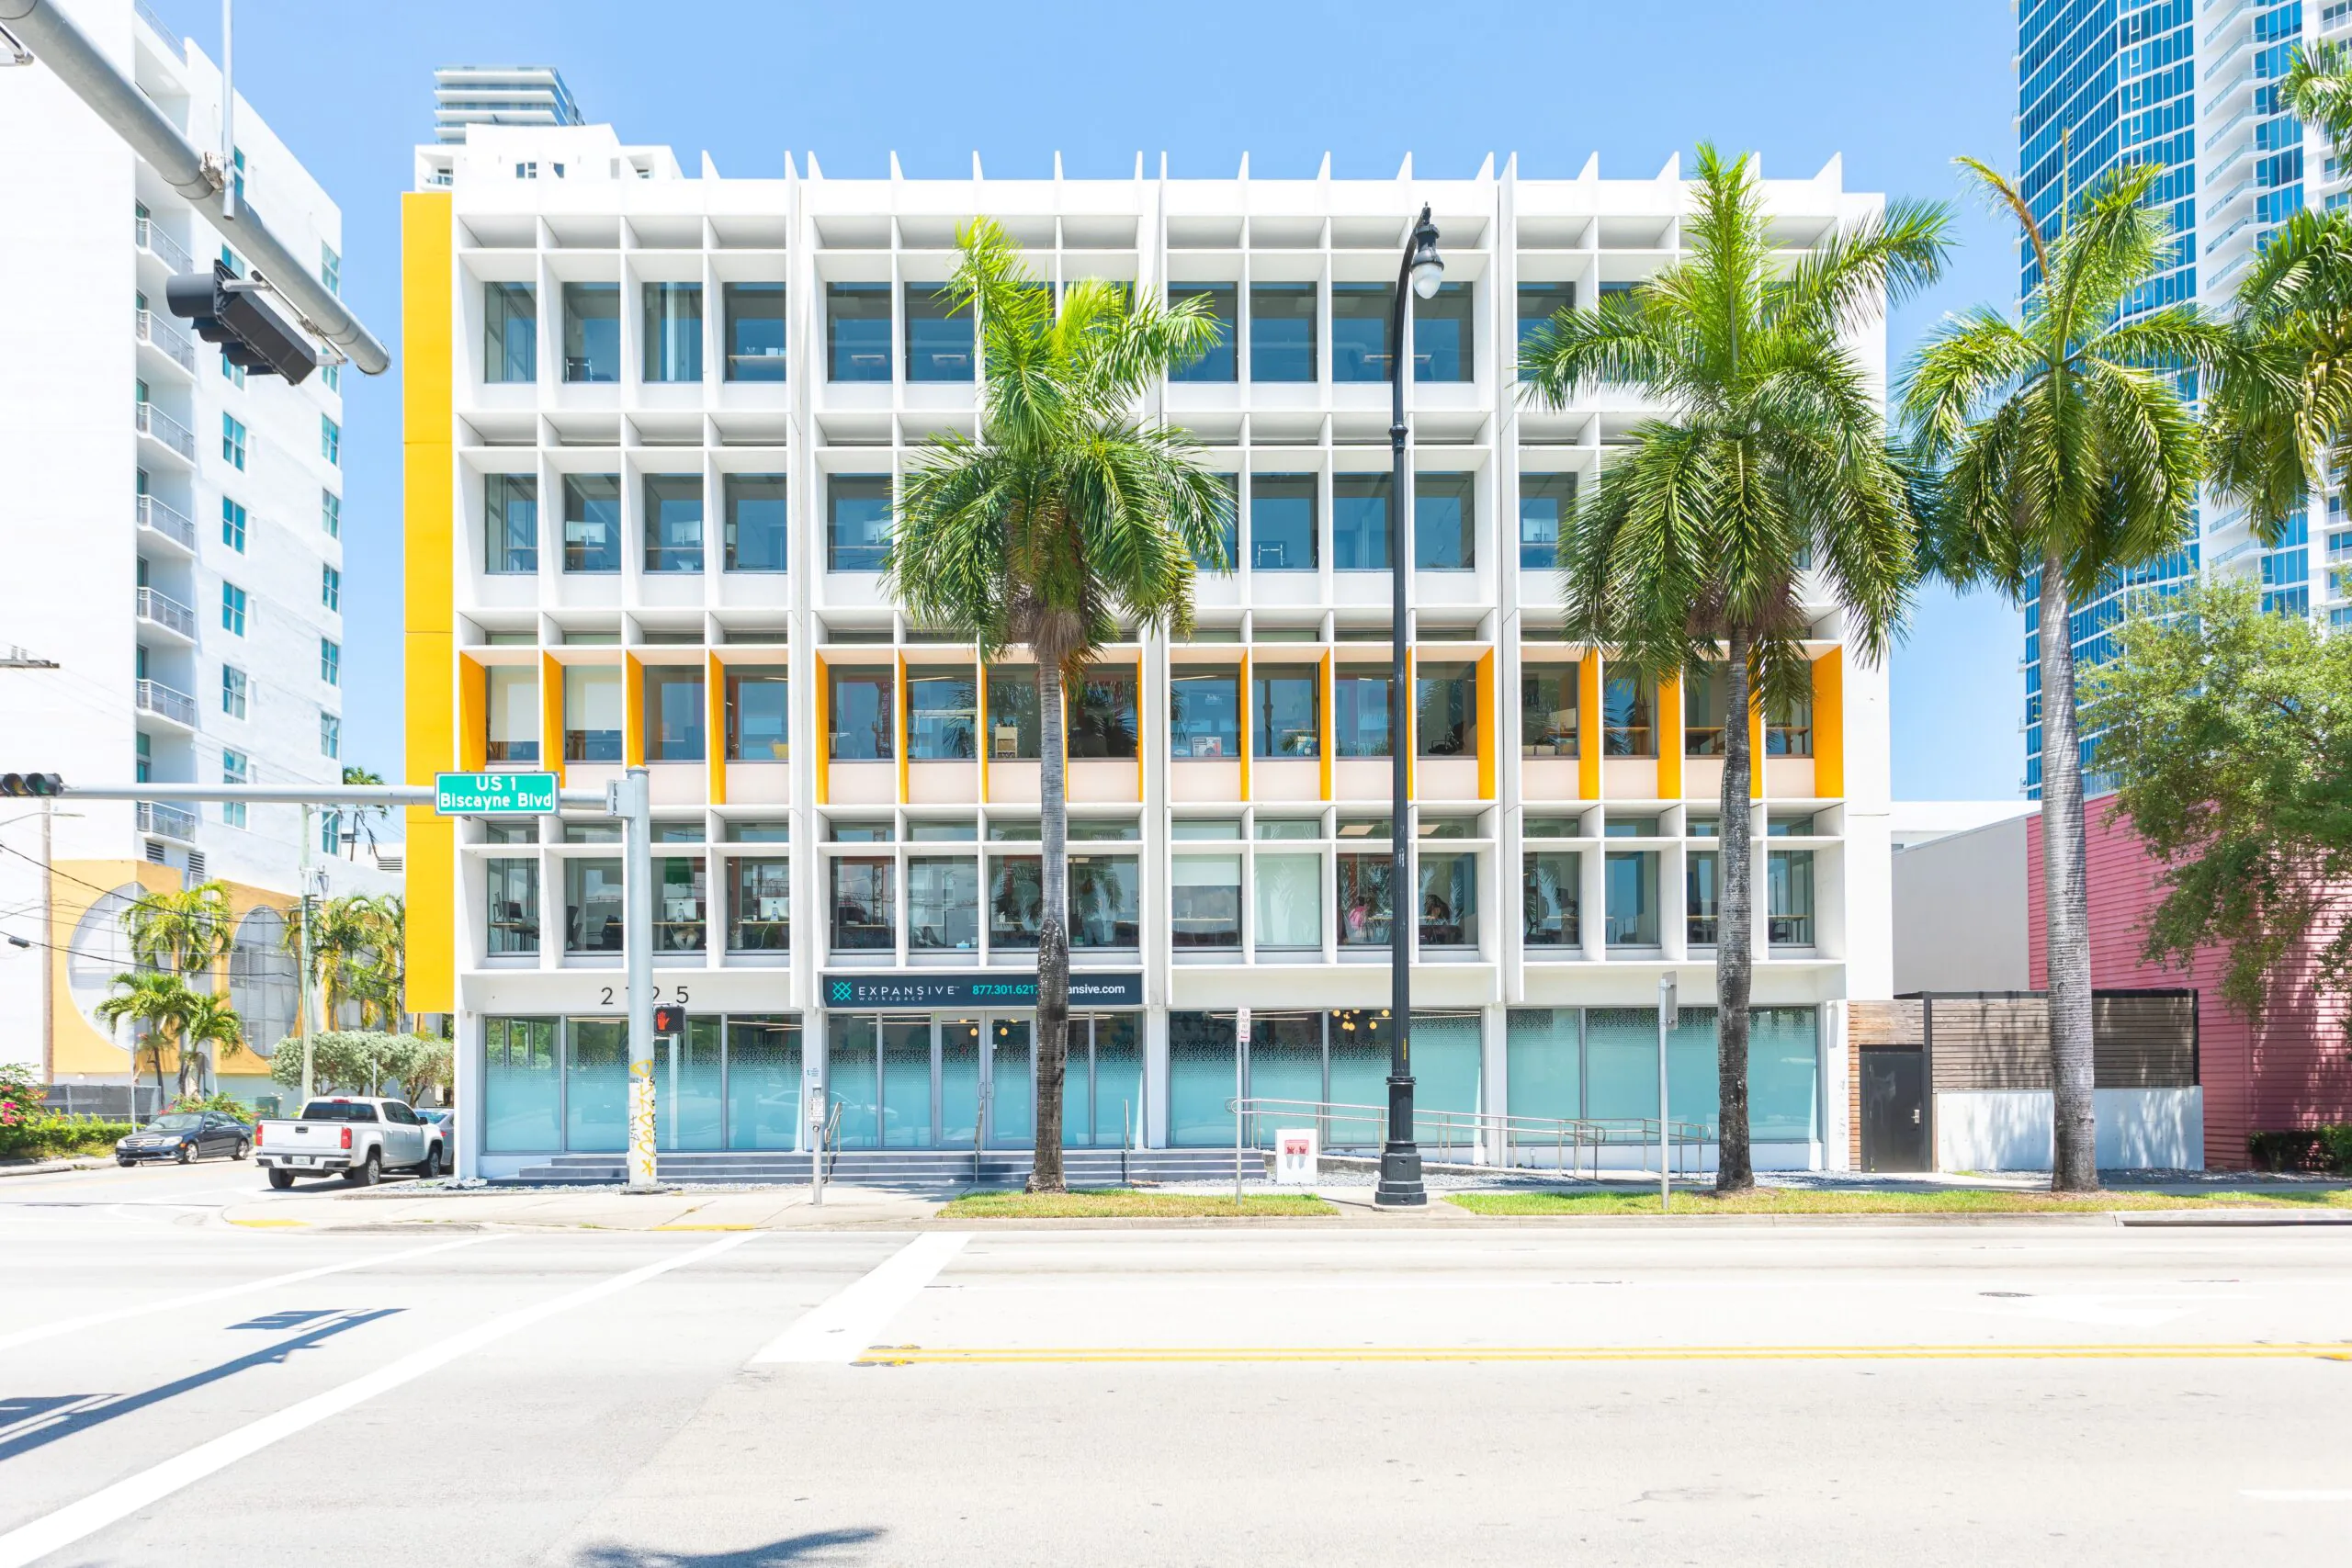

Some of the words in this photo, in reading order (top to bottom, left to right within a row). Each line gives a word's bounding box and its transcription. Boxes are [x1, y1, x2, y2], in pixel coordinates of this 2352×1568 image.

[476, 775, 503, 791] US
[510, 776, 516, 791] 1
[440, 793, 511, 810] Biscayne
[517, 793, 552, 807] Blvd
[1069, 984, 1125, 994] ansive.com
